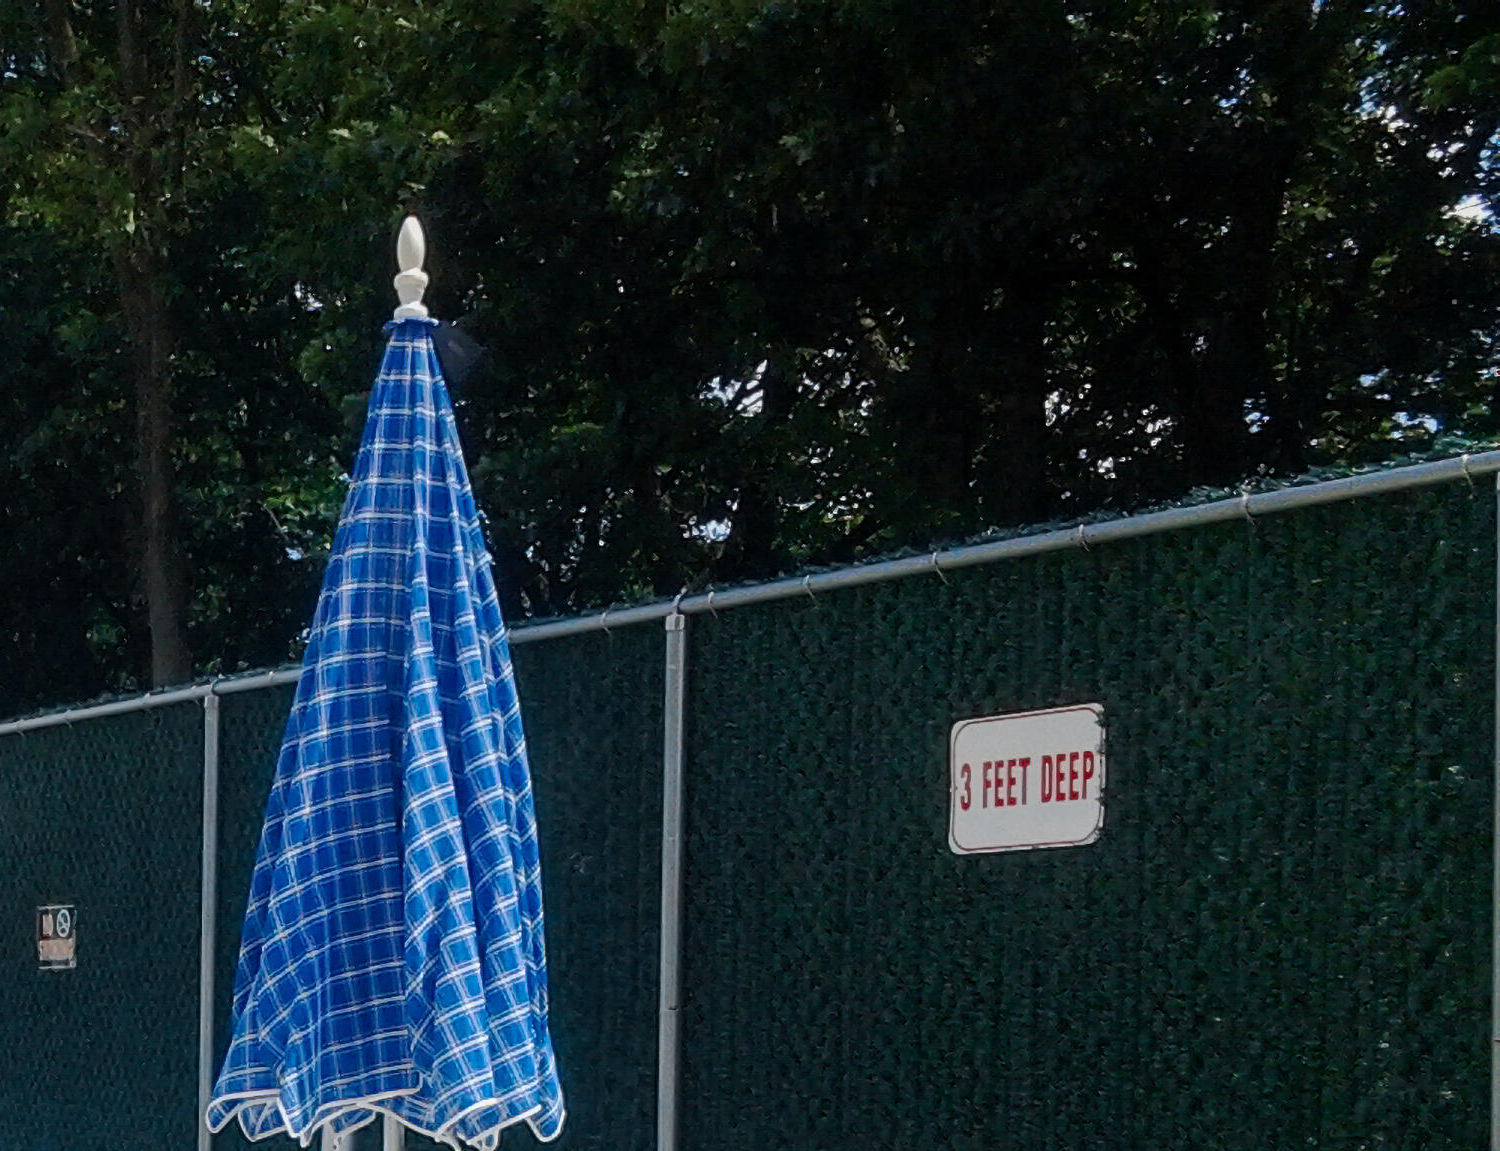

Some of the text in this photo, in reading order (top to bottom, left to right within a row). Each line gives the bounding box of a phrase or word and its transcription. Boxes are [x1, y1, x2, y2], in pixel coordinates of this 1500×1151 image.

[959, 750, 1095, 812] 3 FEET DEEP
